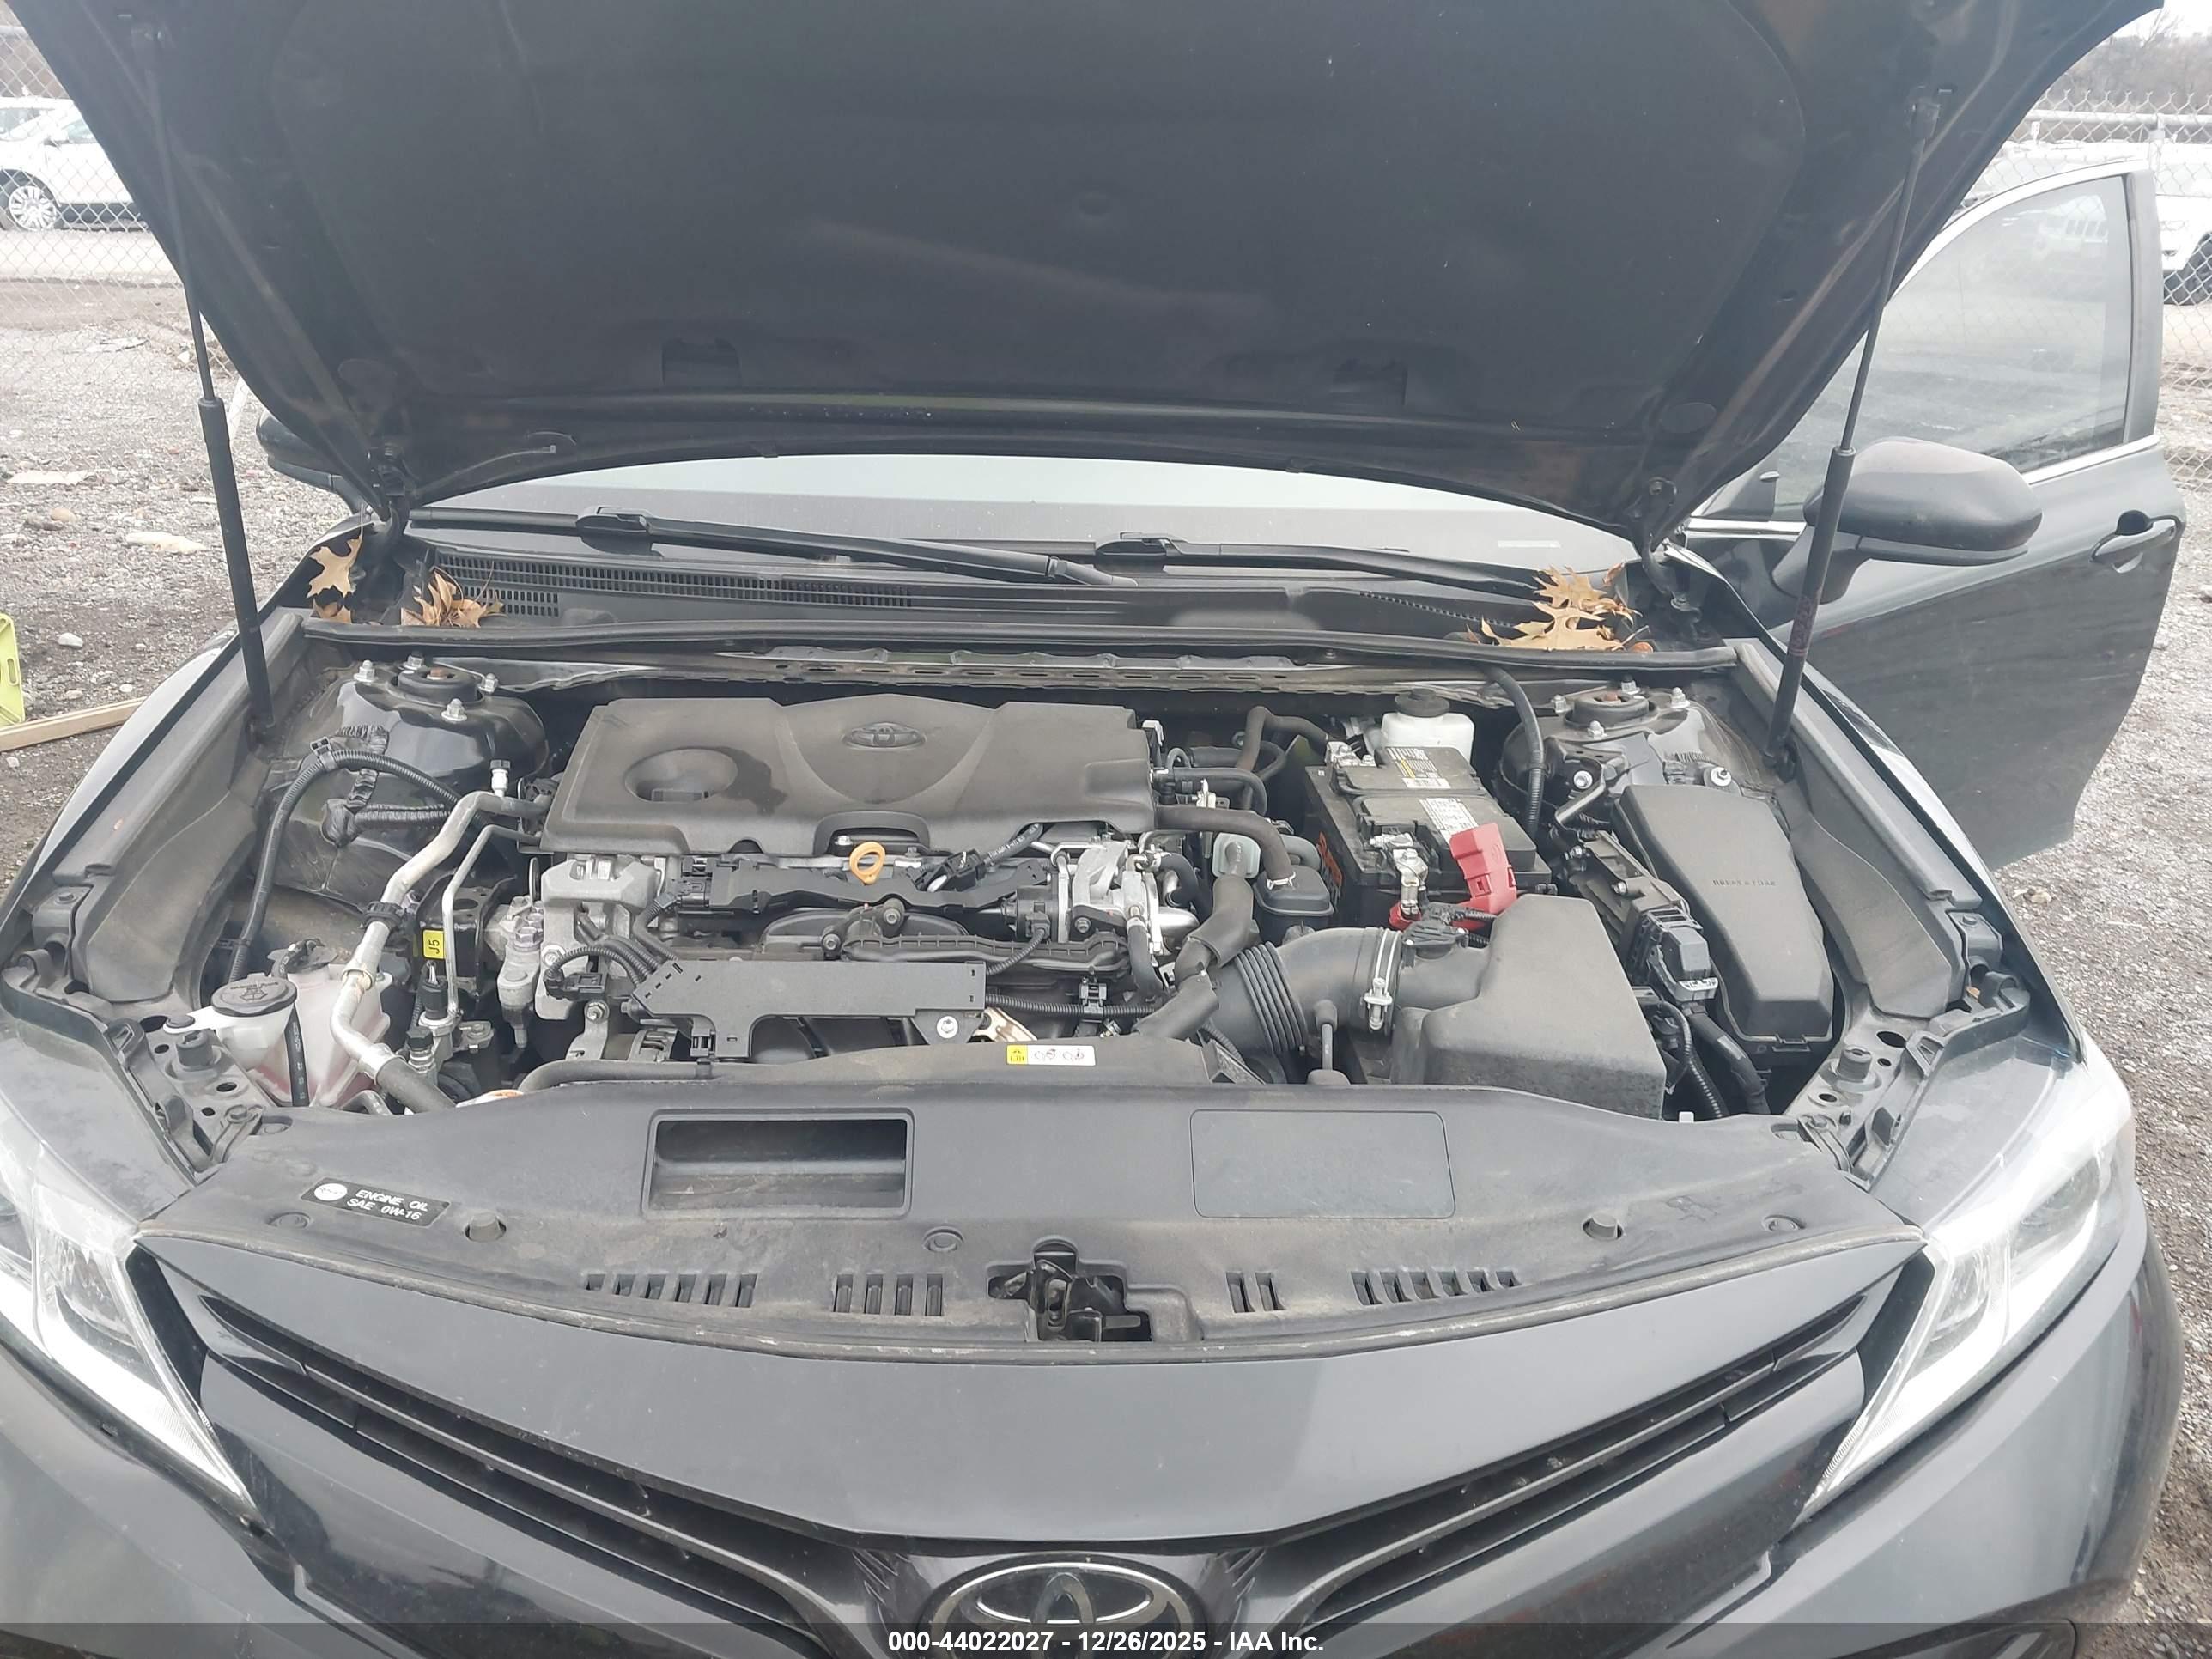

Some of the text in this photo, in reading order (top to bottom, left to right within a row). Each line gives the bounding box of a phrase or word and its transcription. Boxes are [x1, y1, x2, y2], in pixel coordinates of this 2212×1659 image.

[428, 939, 440, 954] J5
[347, 1198, 422, 1220] SAE 0W-16
[356, 1189, 404, 1206] ENGINE
[409, 1200, 428, 1212] OIL
